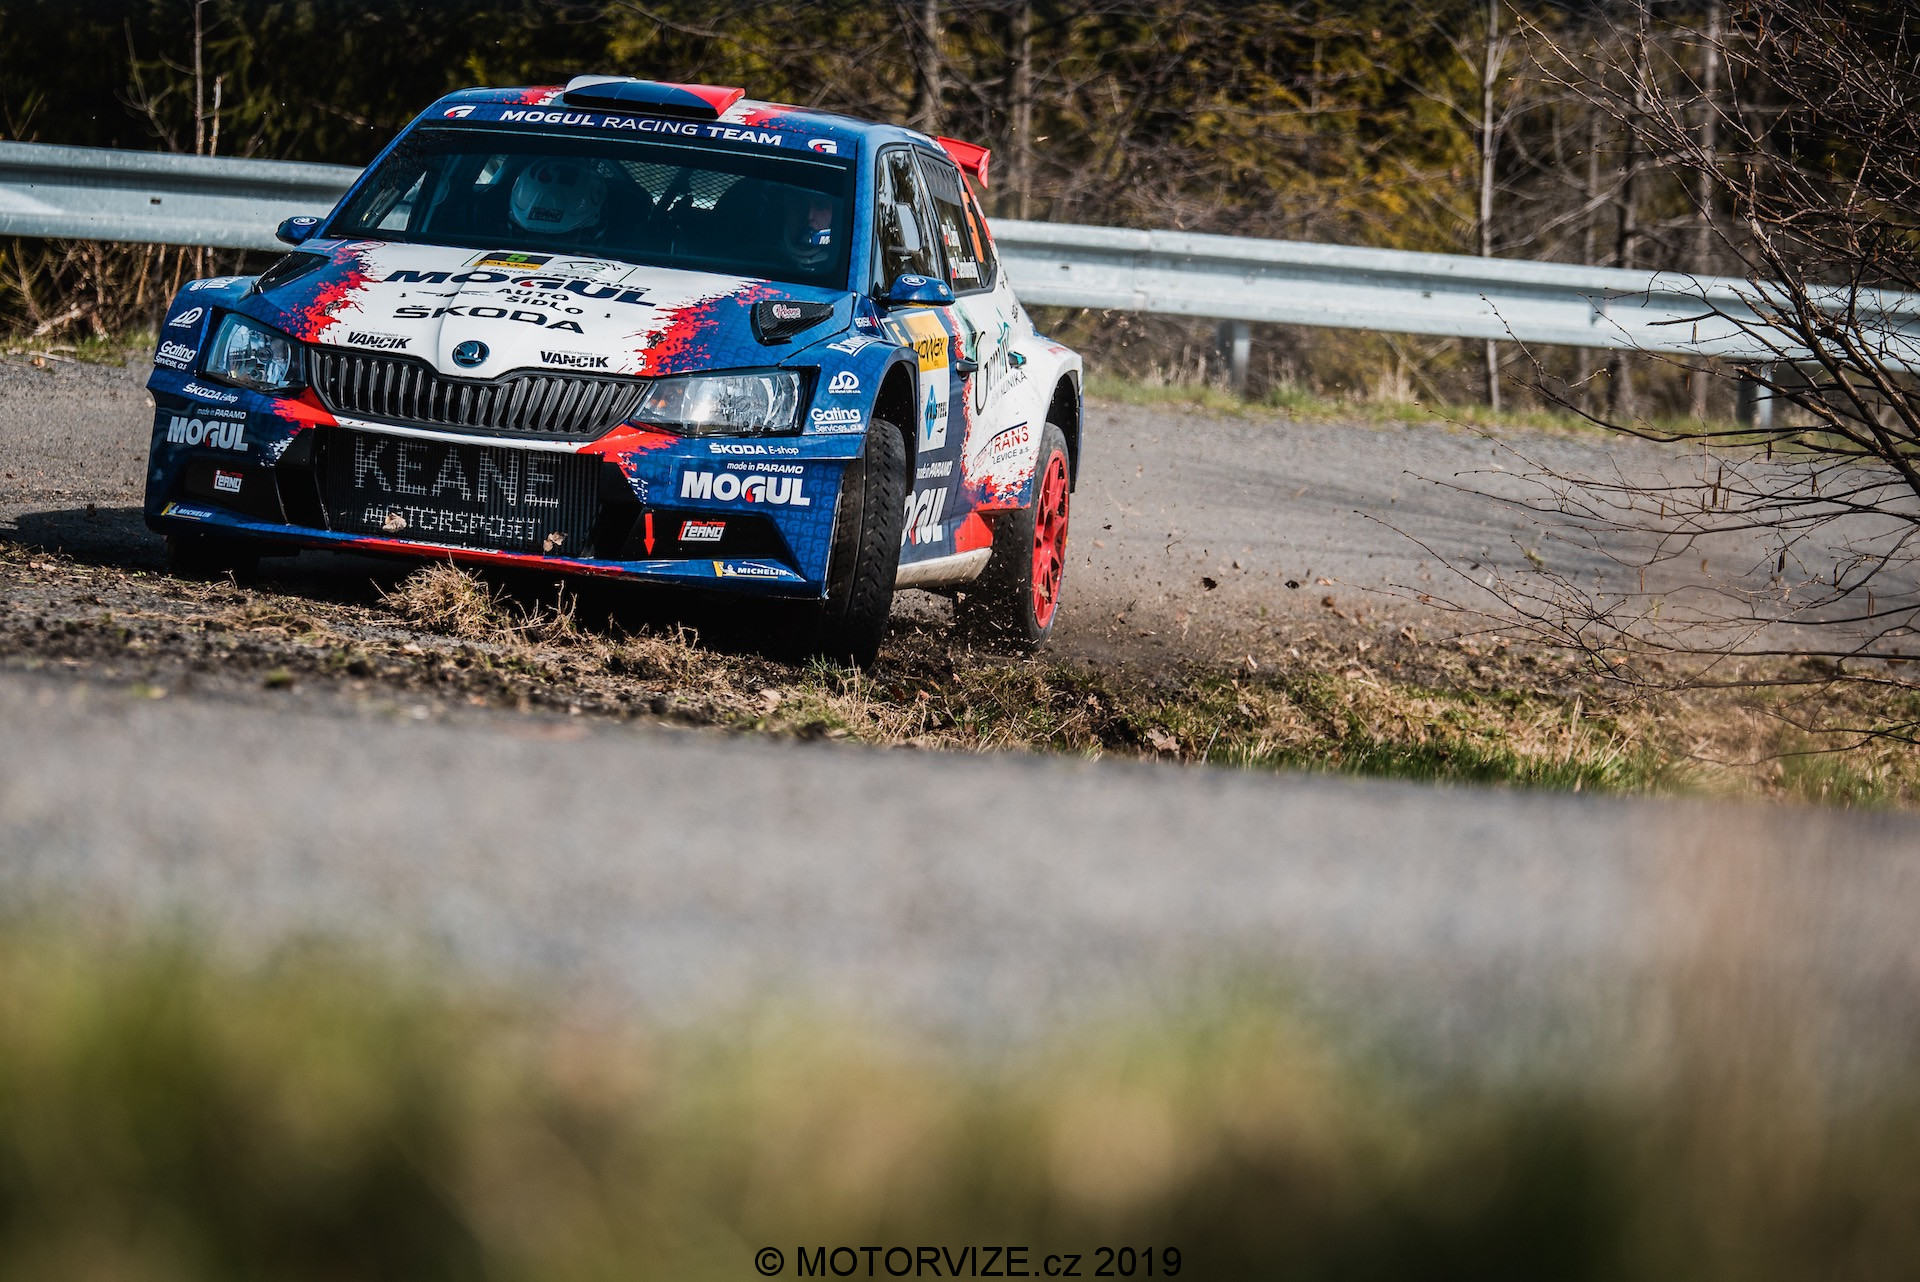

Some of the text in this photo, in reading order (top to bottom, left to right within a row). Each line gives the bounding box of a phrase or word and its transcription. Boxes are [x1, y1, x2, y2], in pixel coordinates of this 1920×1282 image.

[500, 110, 782, 146] MOGUL RACING TEAM
[382, 270, 657, 308] MOGUL
[496, 288, 569, 301] AUTO
[392, 304, 585, 335] ŠKODA
[160, 340, 197, 362] Gating
[183, 382, 222, 401] ŠKODA
[214, 408, 247, 420] PARAMO
[811, 407, 861, 424] Gating
[166, 415, 249, 451] MOGUL
[709, 442, 800, 456] ŠKODA E-shop
[355, 435, 562, 508] KEANE
[726, 461, 804, 475] made in PARAMO
[680, 470, 811, 507] MOGUL
[177, 508, 213, 518] MICHELIN
[737, 567, 787, 576] MICHELIN
